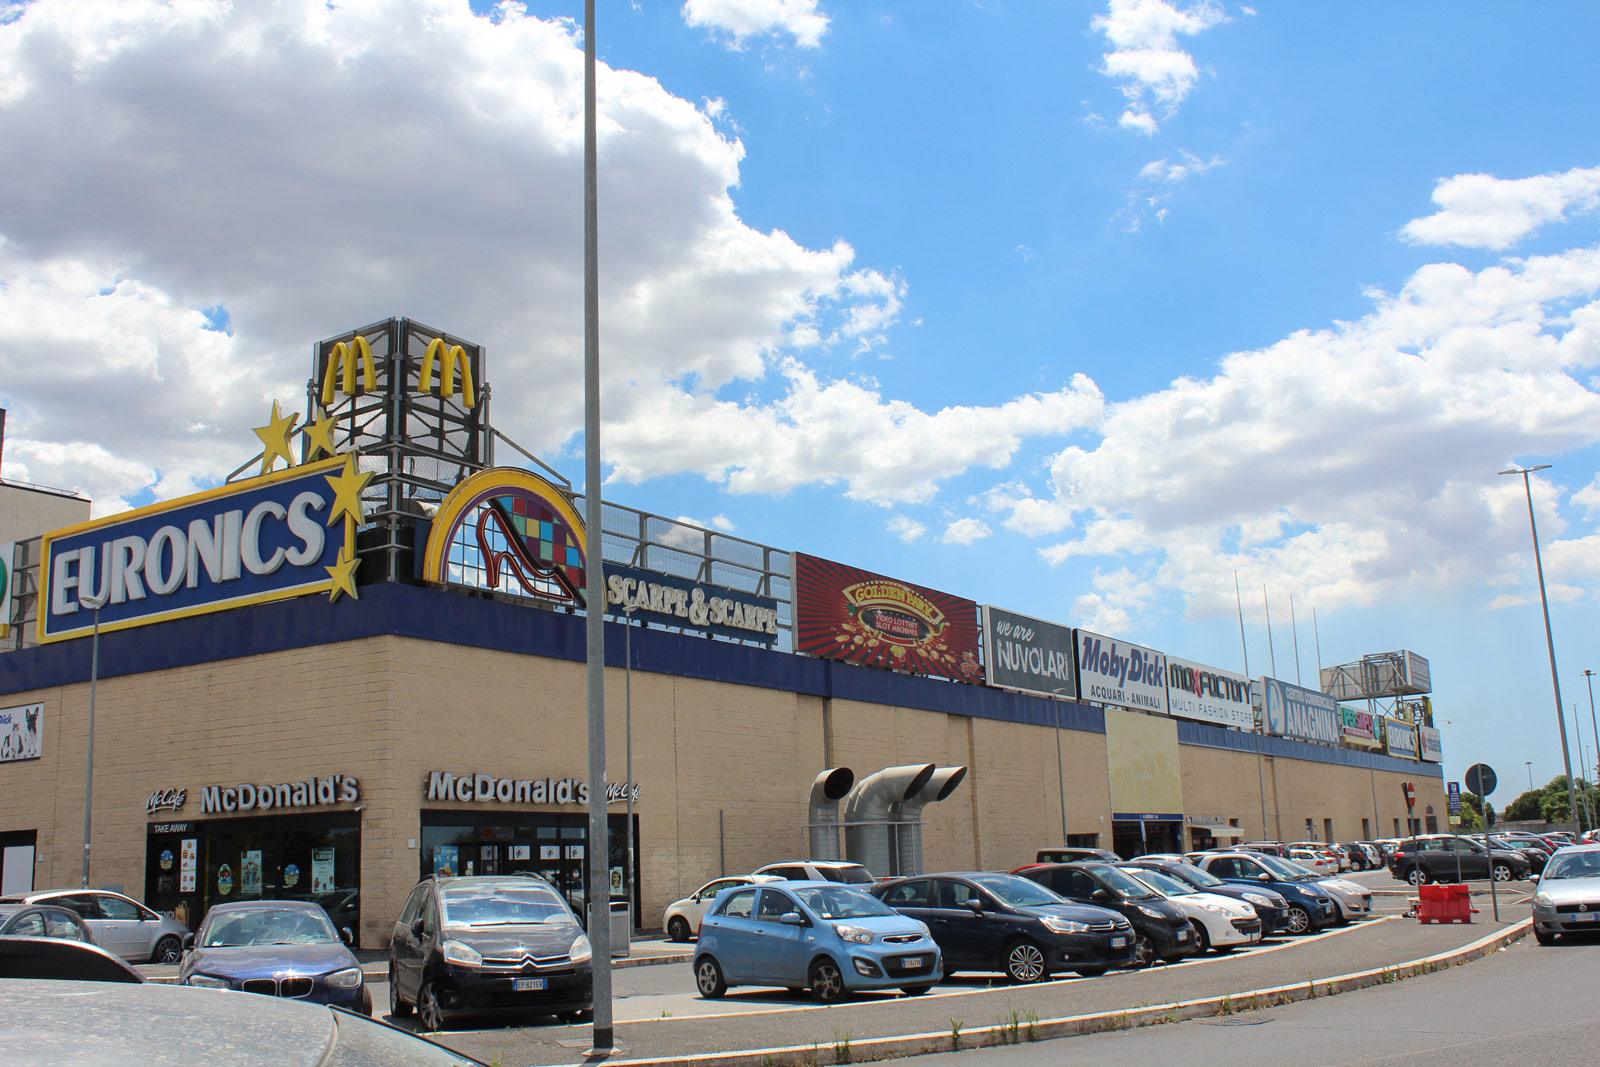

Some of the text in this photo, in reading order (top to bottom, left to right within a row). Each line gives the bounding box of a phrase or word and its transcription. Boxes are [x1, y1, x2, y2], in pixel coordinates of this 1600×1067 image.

[52, 491, 326, 615] EURONICS
[856, 585, 933, 619] GOLDEN PARK
[710, 596, 777, 635] SCARPE
[875, 612, 893, 624] VIDEO
[876, 621, 891, 631] SLOT
[997, 620, 1035, 641] we are
[1091, 684, 1125, 702] ACQUARI
[1132, 692, 1160, 709] ANIMALI
[1171, 698, 1253, 724] MULTI FASHION STORE
[1286, 700, 1340, 743] ANAGNINA
[1387, 725, 1417, 752] EURONICS
[200, 775, 359, 813] McDonald's
[427, 771, 590, 805] McDonald's
[606, 782, 642, 804] McCfé
[154, 823, 187, 833] TAKE AWAY
